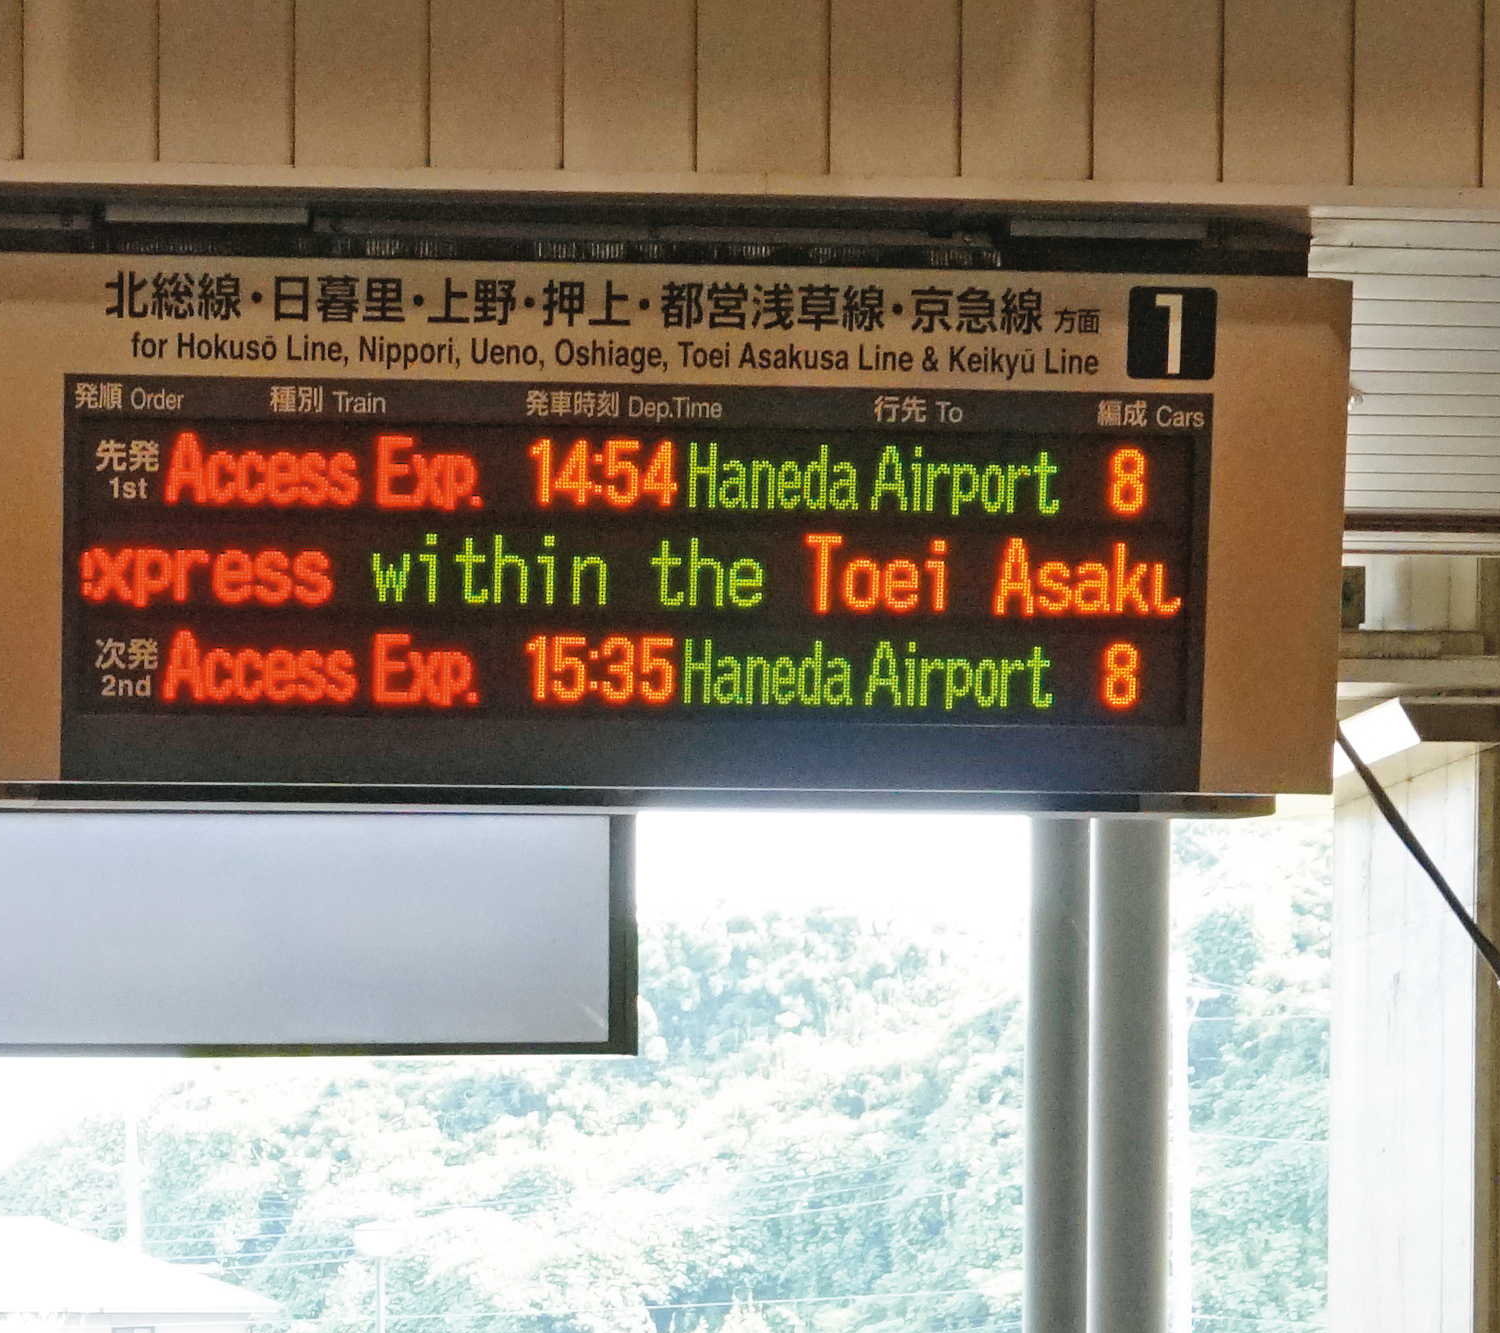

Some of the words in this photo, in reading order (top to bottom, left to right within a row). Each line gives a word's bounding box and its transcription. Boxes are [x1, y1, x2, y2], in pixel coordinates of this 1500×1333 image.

[1053, 308, 1100, 335] 方面
[1154, 294, 1183, 375] 1
[131, 333, 168, 359] for
[286, 335, 350, 368] Line,
[359, 336, 460, 369] Nippori,
[470, 340, 544, 370] Ueno,
[554, 340, 668, 373] Oshiage,
[678, 342, 730, 368] Toei
[739, 343, 848, 371] Asakusa
[858, 345, 913, 372] Line
[922, 347, 938, 372] &
[1045, 348, 1099, 375] Line
[75, 383, 122, 410] 発順
[130, 387, 184, 411] Order
[269, 386, 323, 413] 種別
[332, 390, 386, 413] Train
[525, 390, 620, 418] 発車時刻
[628, 394, 722, 424] Dep.Time
[875, 395, 927, 423] 行先
[935, 401, 963, 423] To
[1098, 401, 1147, 427] 編成
[1156, 405, 1205, 428] Cars
[95, 440, 159, 472] 先発
[109, 477, 148, 499] 1st
[165, 432, 359, 505] Access
[376, 435, 483, 509] Exp.
[529, 438, 677, 506] 14:54
[688, 441, 859, 510] Haneda
[870, 445, 1059, 516] Airport
[1109, 448, 1147, 514] 8
[80, 546, 333, 606] xpress
[371, 533, 608, 606] within
[650, 537, 764, 607] the
[805, 533, 949, 612] Toei
[95, 638, 158, 670] 次発
[162, 630, 356, 704] Access
[372, 632, 479, 705] Exp.
[527, 634, 675, 702] 15:35
[684, 638, 853, 706] Haneda
[864, 640, 1054, 708] Airport
[1103, 641, 1140, 707] 8
[101, 675, 151, 697] 2nd
